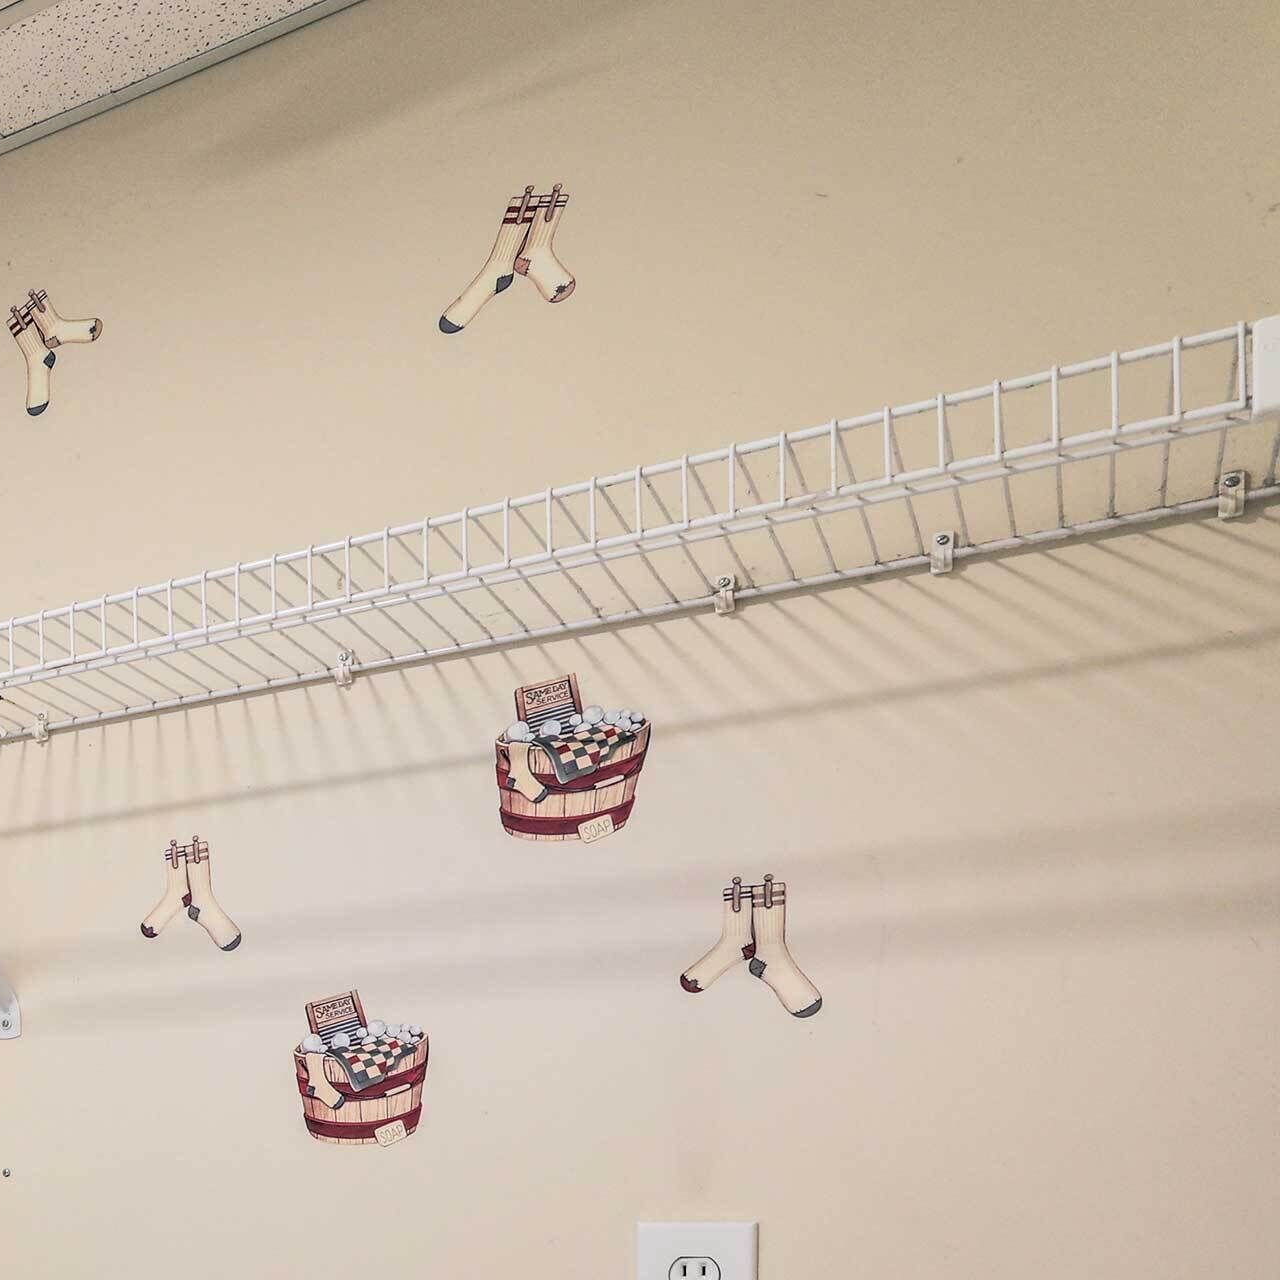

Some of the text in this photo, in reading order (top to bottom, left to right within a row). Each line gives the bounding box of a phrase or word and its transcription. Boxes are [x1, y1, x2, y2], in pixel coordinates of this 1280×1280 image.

[536, 690, 569, 705] SERVICE
[583, 819, 611, 840] SOAP
[325, 1005, 354, 1019] SERVICE
[380, 1124, 404, 1144] SOAP
